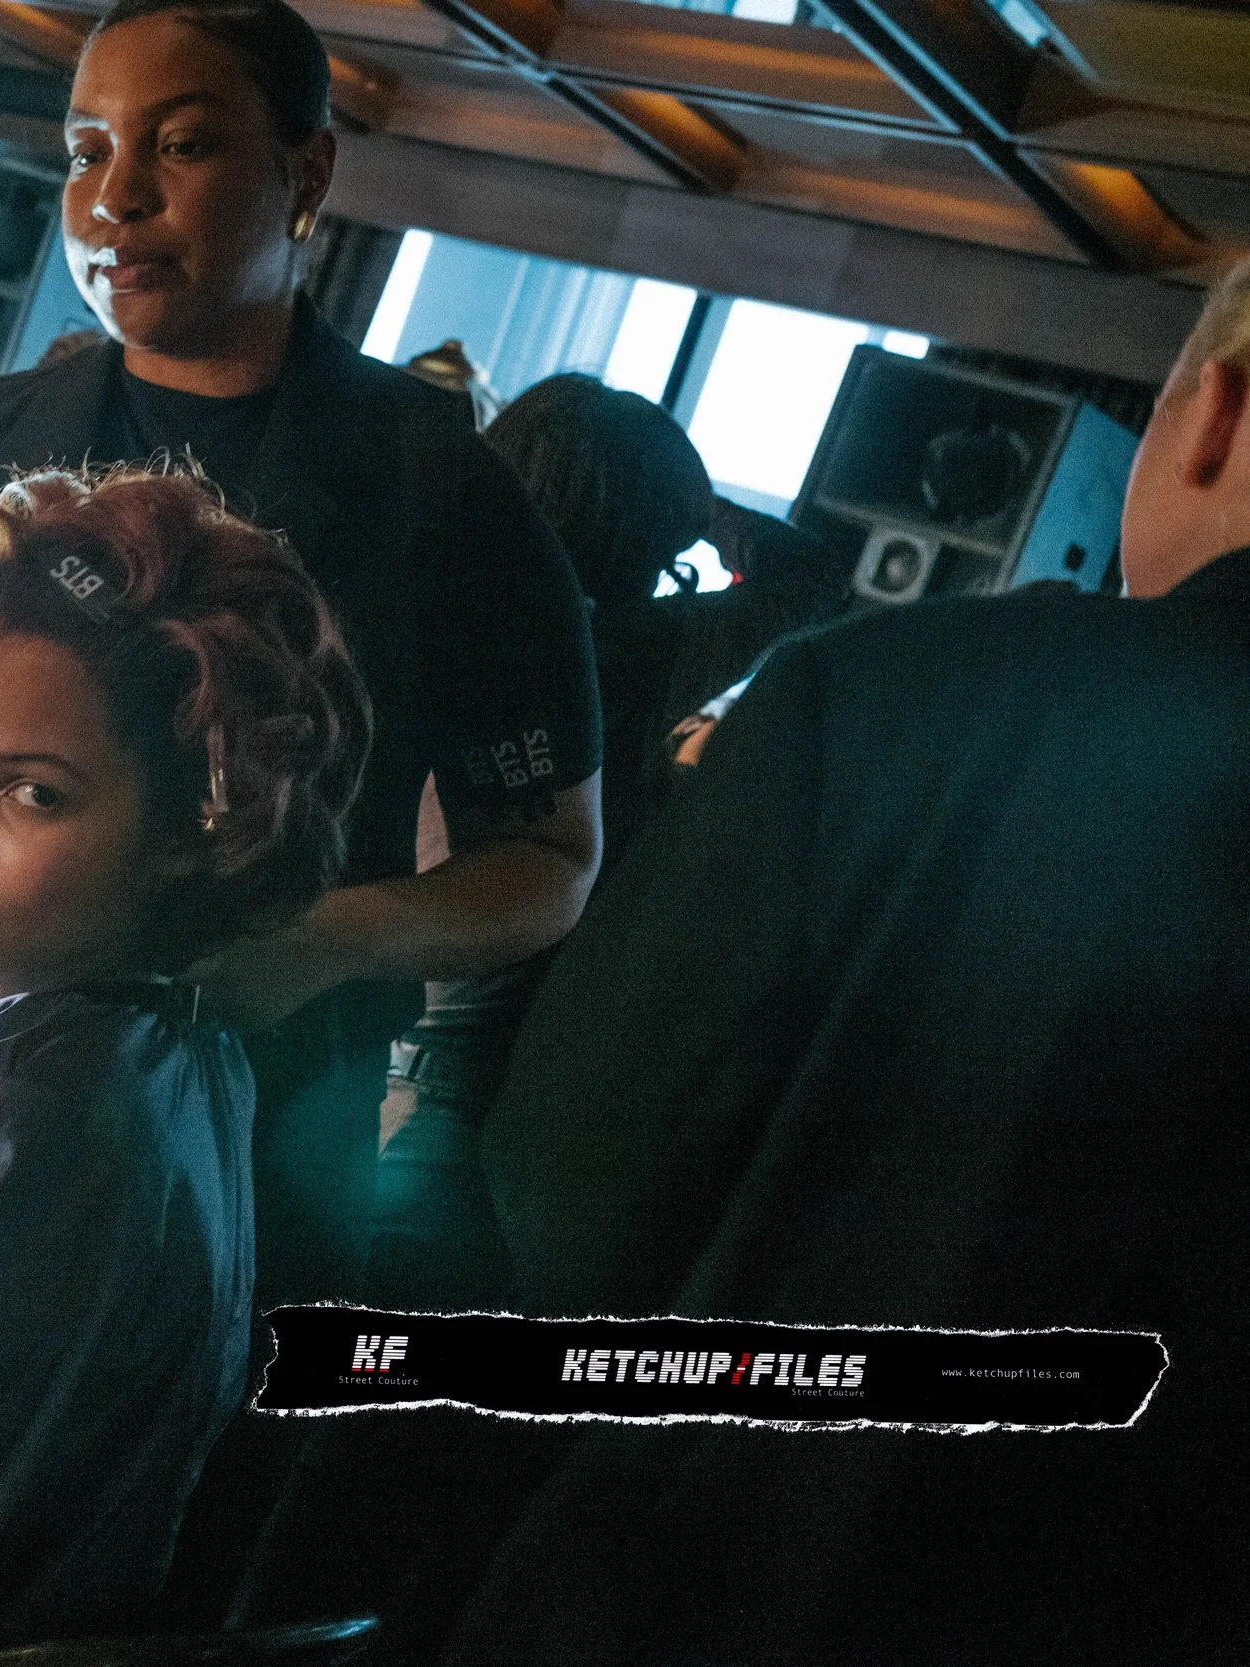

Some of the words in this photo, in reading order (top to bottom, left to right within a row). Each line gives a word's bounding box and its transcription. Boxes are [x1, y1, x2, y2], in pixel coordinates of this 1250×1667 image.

[49, 555, 104, 600] BTS
[490, 740, 529, 787] BTS
[523, 728, 553, 777] BTS
